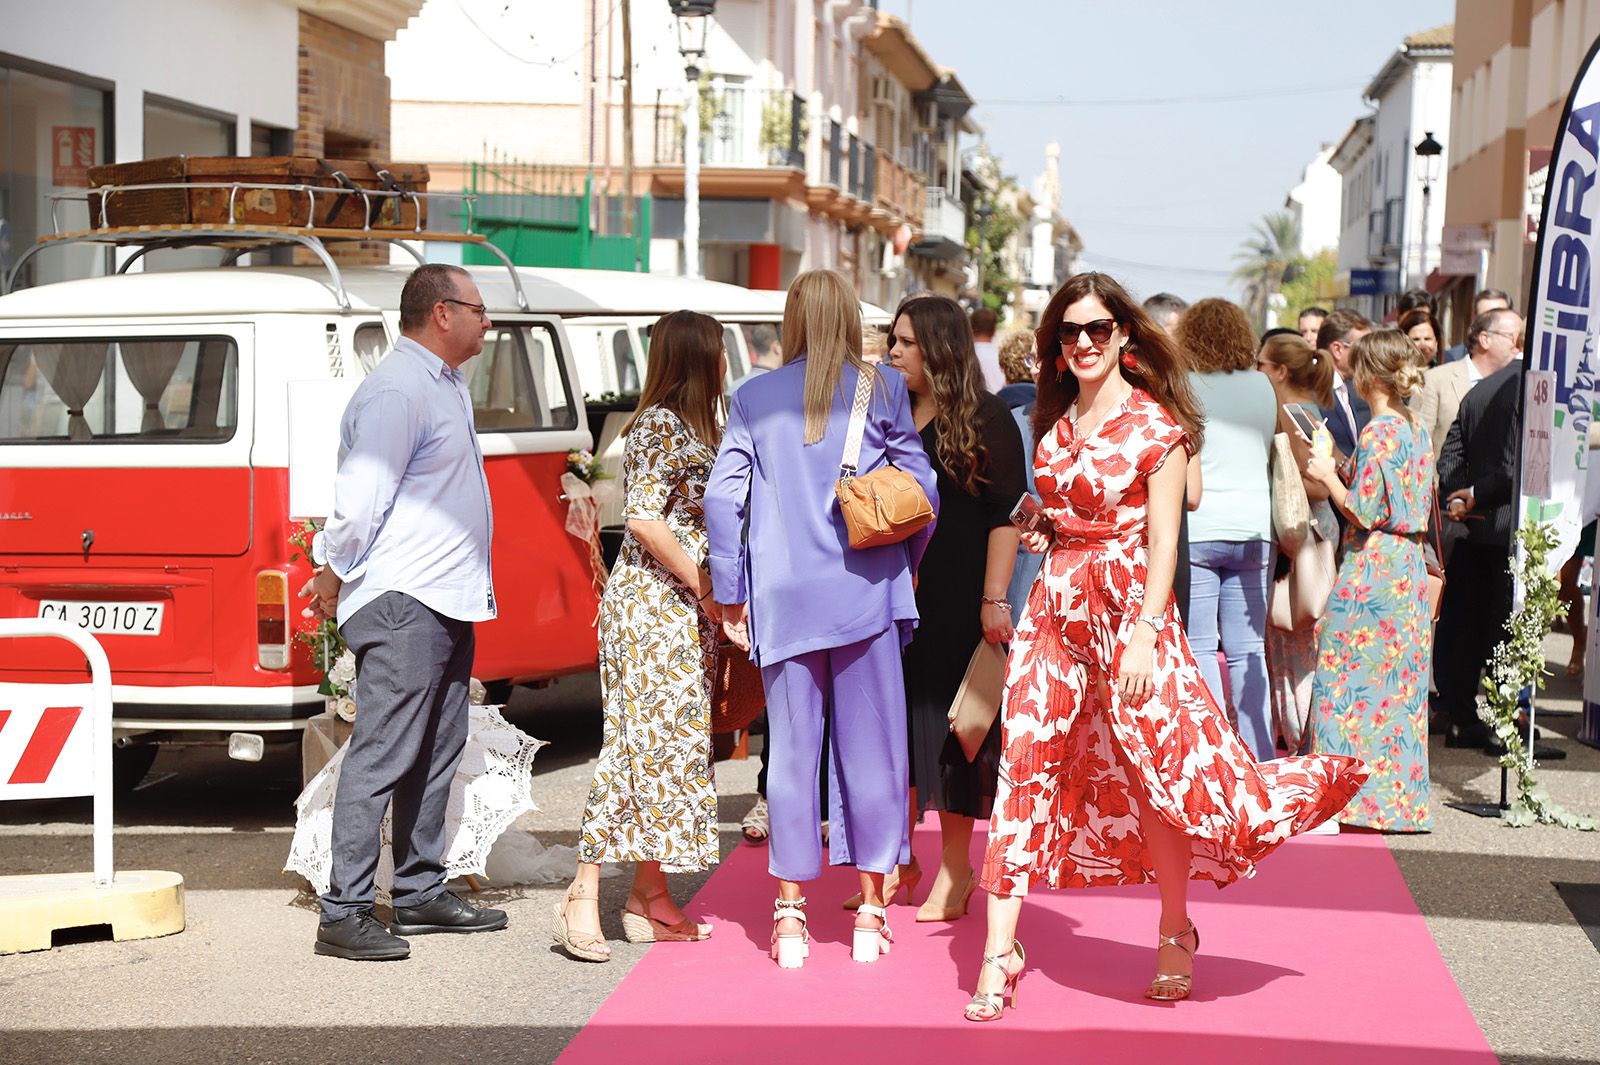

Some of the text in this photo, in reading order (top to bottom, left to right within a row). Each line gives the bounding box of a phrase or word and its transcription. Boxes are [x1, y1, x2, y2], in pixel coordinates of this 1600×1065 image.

[1534, 380, 1548, 405] 48
[41, 604, 158, 631] CA 3010 Z
